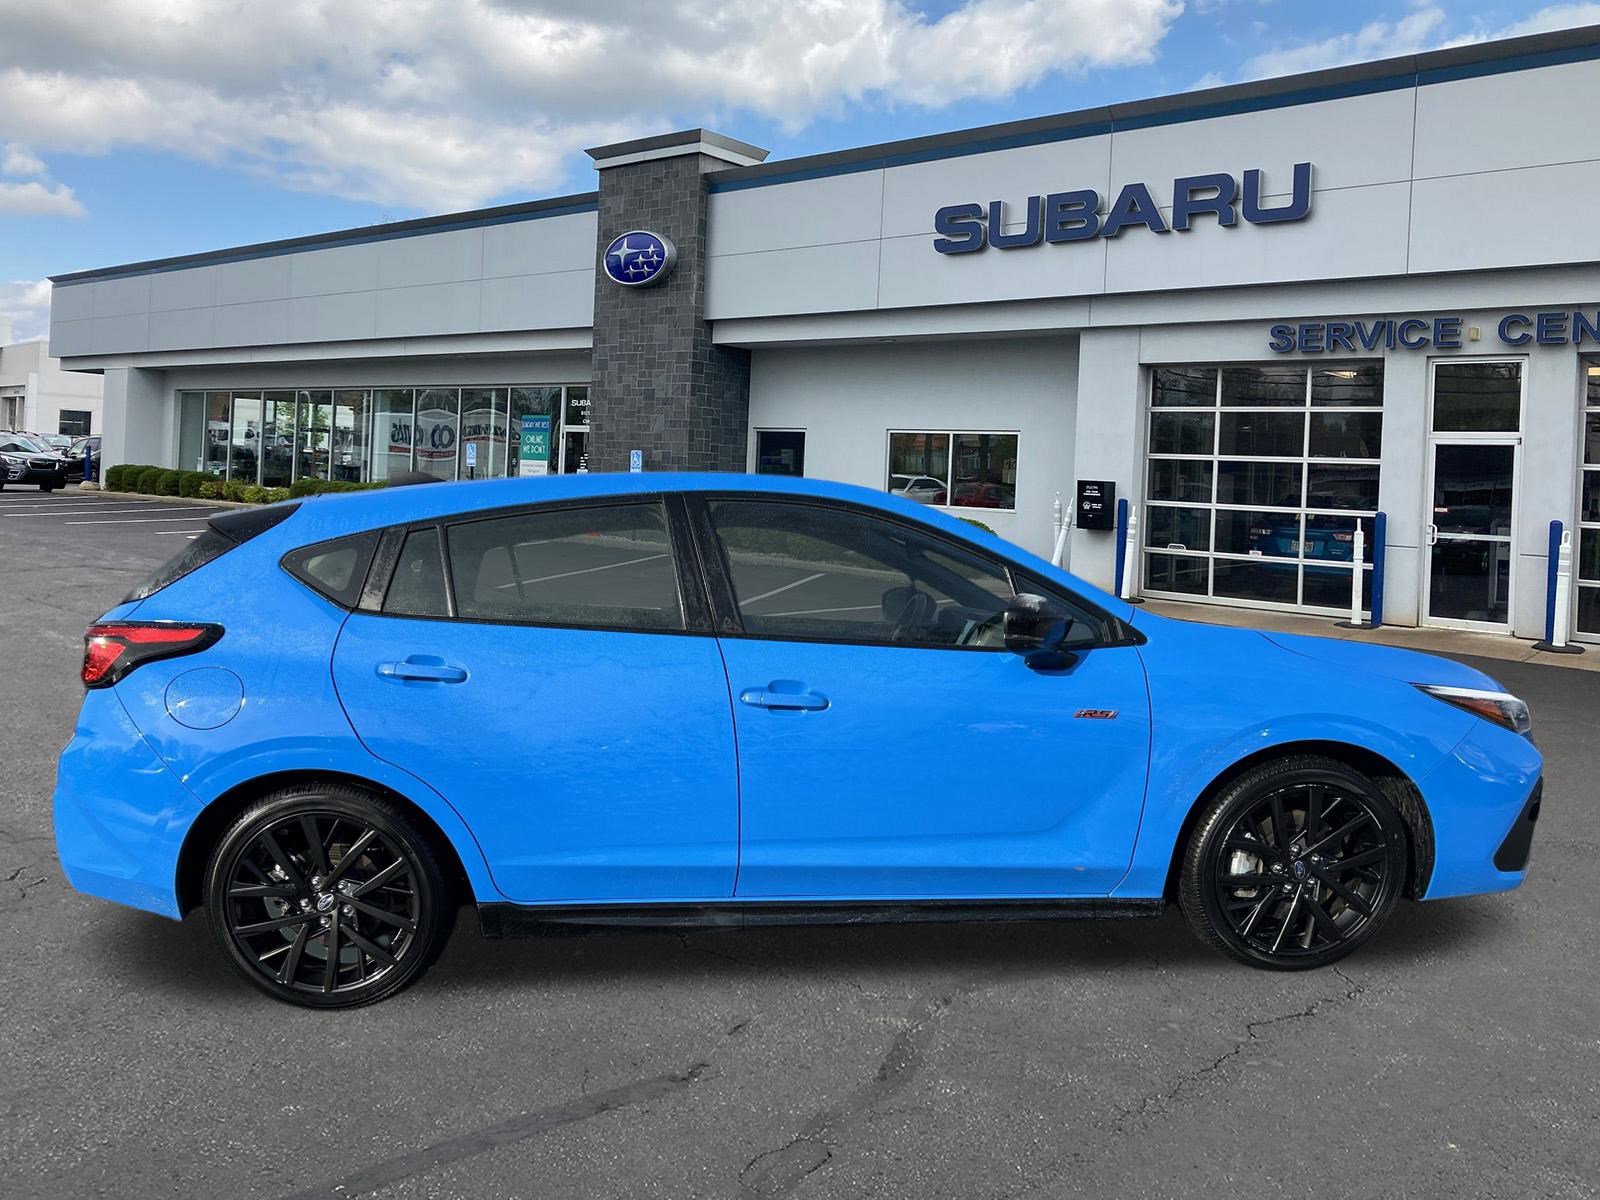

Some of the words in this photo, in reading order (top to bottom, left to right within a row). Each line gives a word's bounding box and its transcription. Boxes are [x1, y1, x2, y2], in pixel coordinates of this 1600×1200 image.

[933, 162, 1313, 255] SUBARU
[1269, 317, 1463, 353] SERVICE
[1498, 311, 1600, 346] CEN
[571, 399, 592, 407] SUBA
